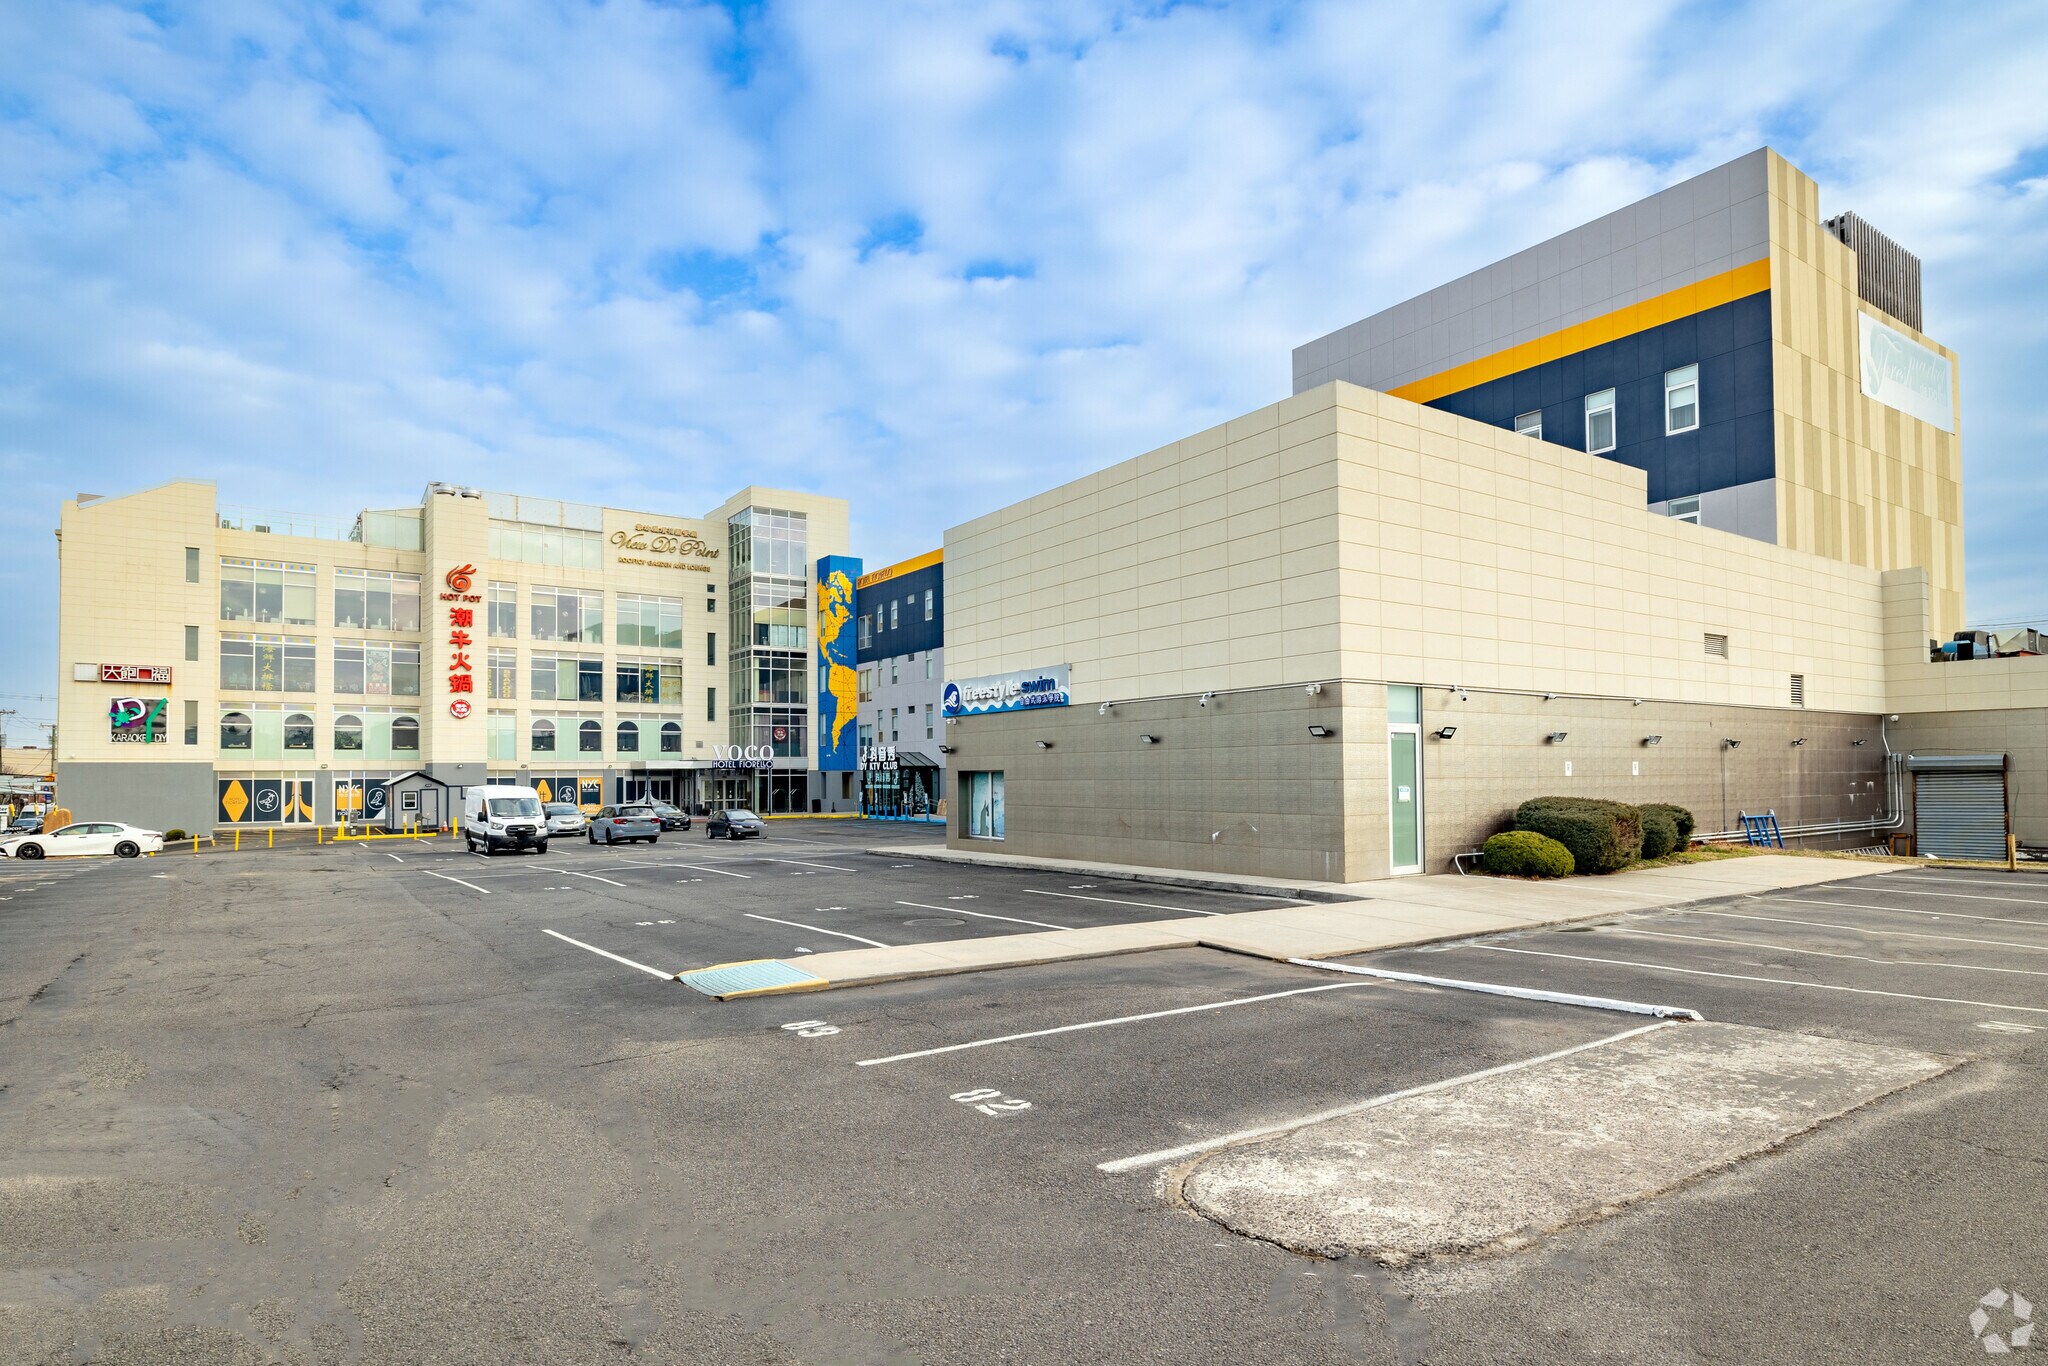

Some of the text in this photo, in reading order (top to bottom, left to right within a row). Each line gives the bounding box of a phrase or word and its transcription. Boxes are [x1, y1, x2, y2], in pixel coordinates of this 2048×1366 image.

[610, 531, 648, 549] View
[680, 539, 720, 559] Point
[440, 592, 482, 603] HOT POT
[449, 607, 473, 694] 潮牛火鍋
[962, 676, 1060, 701] freestyle swim
[713, 760, 774, 768] HOTEL FIORELLO
[869, 762, 881, 770] KTV
[882, 761, 898, 770] CLUB
[338, 784, 361, 794] NYC
[582, 779, 599, 789] NYC
